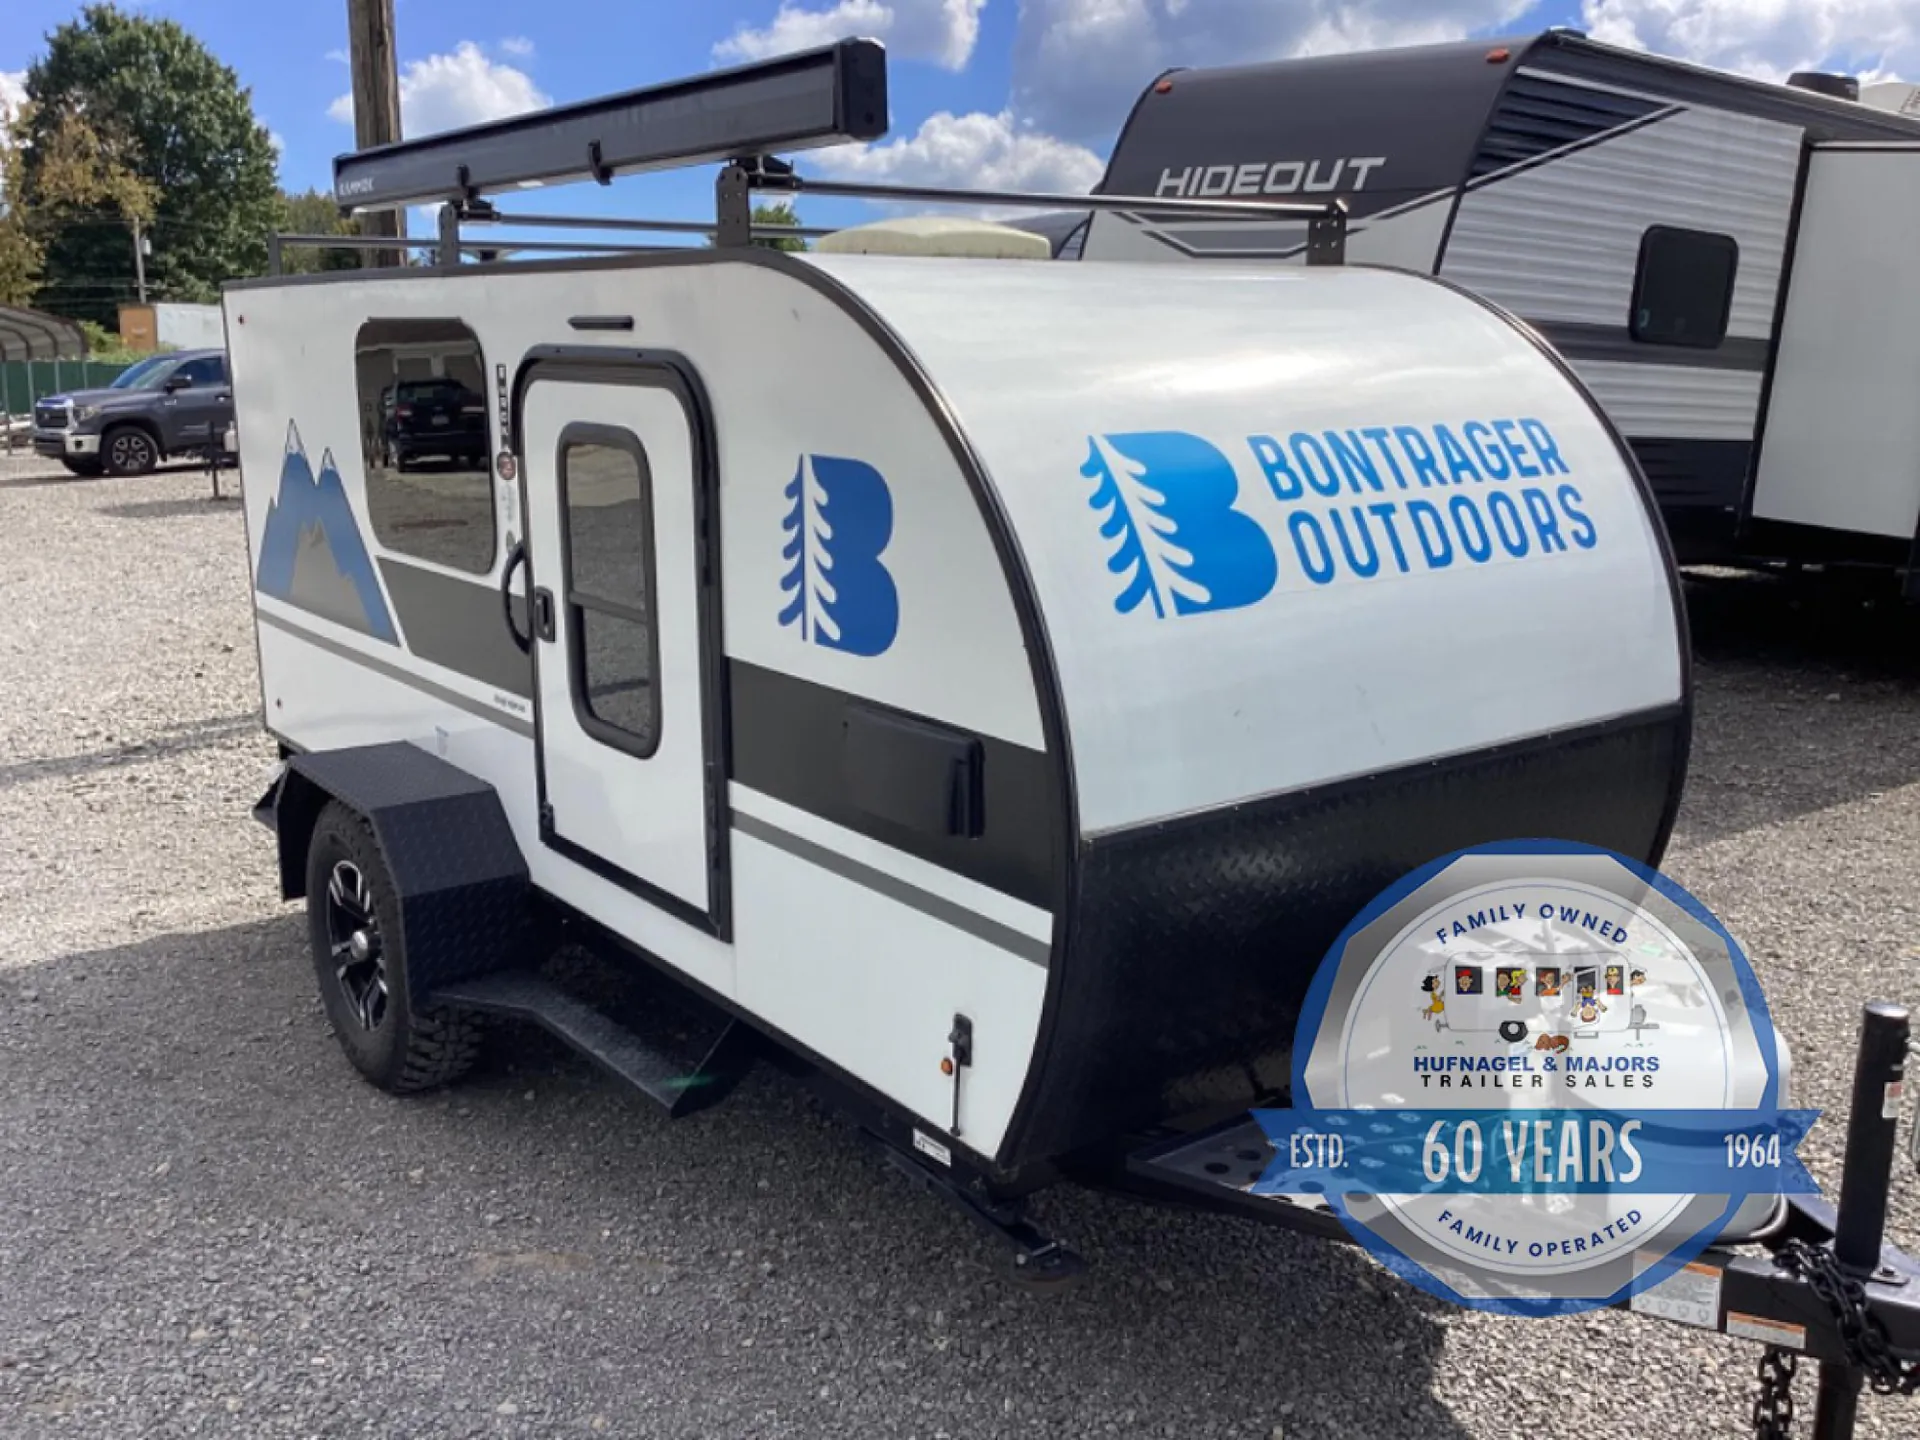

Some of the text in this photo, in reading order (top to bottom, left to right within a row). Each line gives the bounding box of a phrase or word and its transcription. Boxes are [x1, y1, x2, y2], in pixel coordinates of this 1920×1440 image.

[1155, 156, 1387, 196] HIDEOUT
[1246, 417, 1570, 501] BONTRAGER
[1287, 484, 1597, 585] OUTDOORS
